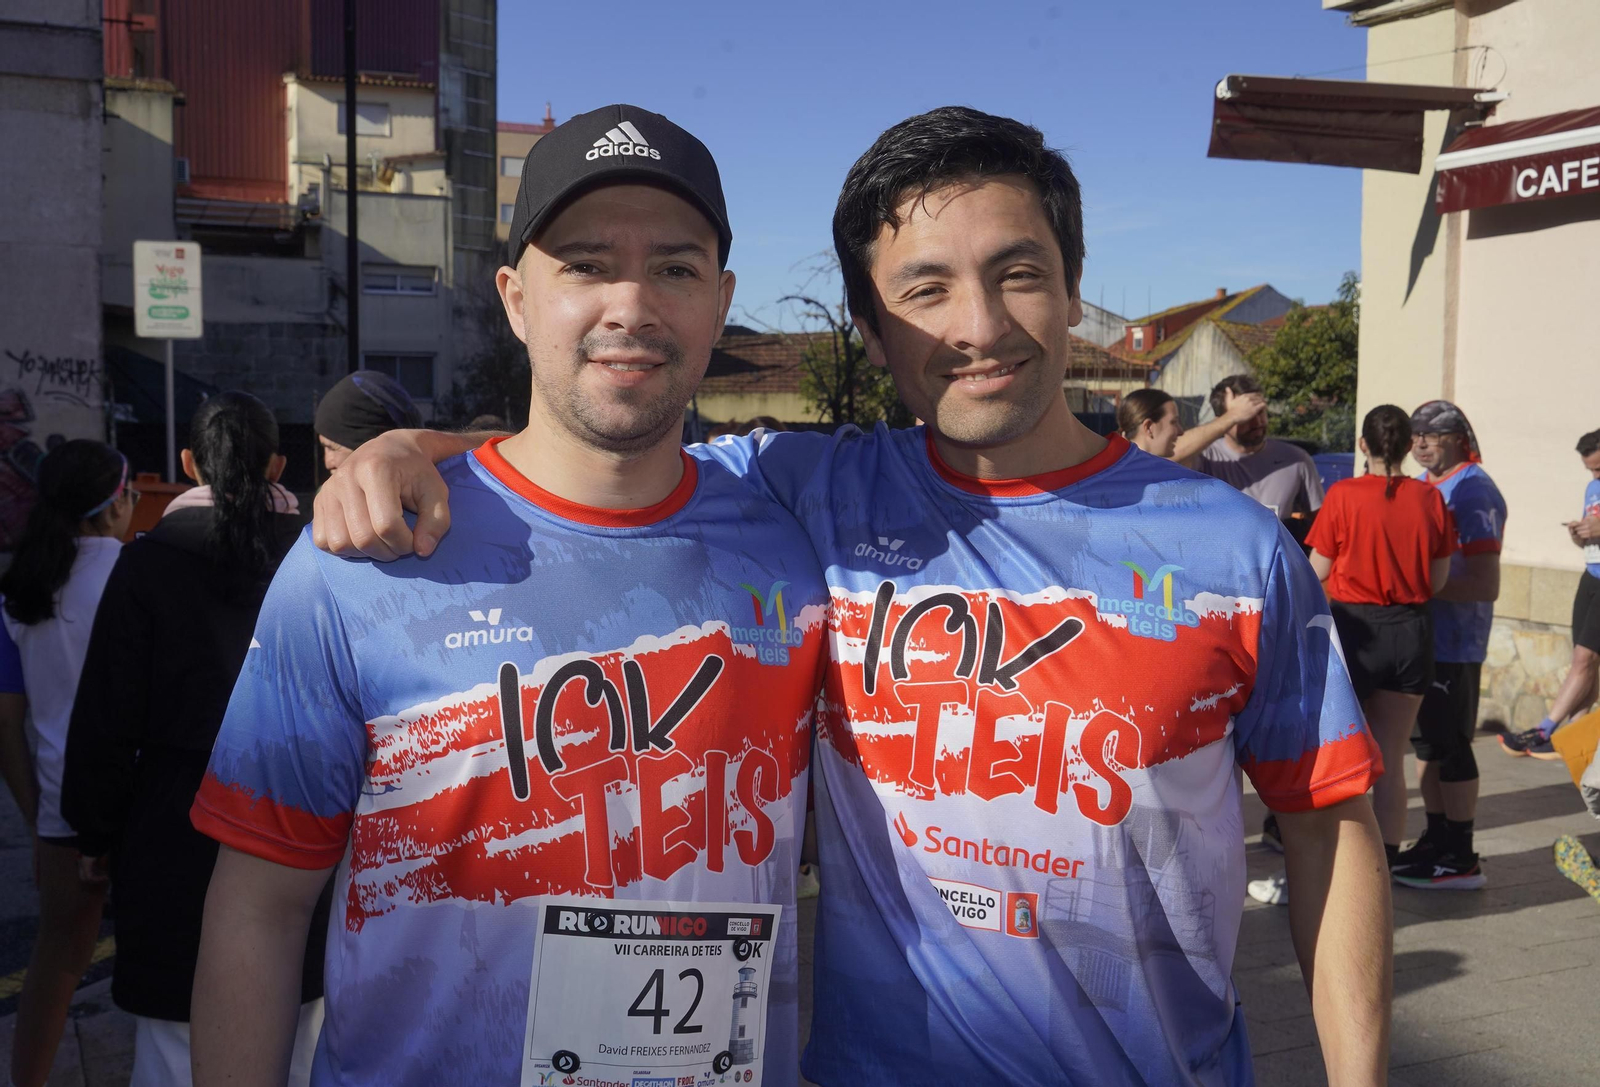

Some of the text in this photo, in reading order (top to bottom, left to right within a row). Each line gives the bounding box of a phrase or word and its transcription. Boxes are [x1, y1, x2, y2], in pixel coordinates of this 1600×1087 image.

[585, 141, 661, 160] adidas
[854, 542, 923, 570] amura
[1100, 597, 1198, 625] mercado
[444, 626, 533, 649] amura
[731, 621, 803, 645] mercado
[1131, 613, 1173, 639] teis
[758, 643, 788, 663] teis
[894, 680, 1142, 828] TEIS
[549, 746, 780, 888] TEIS
[923, 825, 1085, 879] Santander
[933, 885, 996, 909] NCELLO
[951, 904, 987, 920] VIGO
[614, 943, 631, 955] VII
[633, 944, 690, 957] CARREIRA
[691, 945, 704, 957] DE
[705, 945, 722, 956] TEIS
[627, 968, 704, 1035] 42
[598, 1042, 712, 1056] David FREIXES FERNANDEZ
[576, 1076, 630, 1087] Santander
